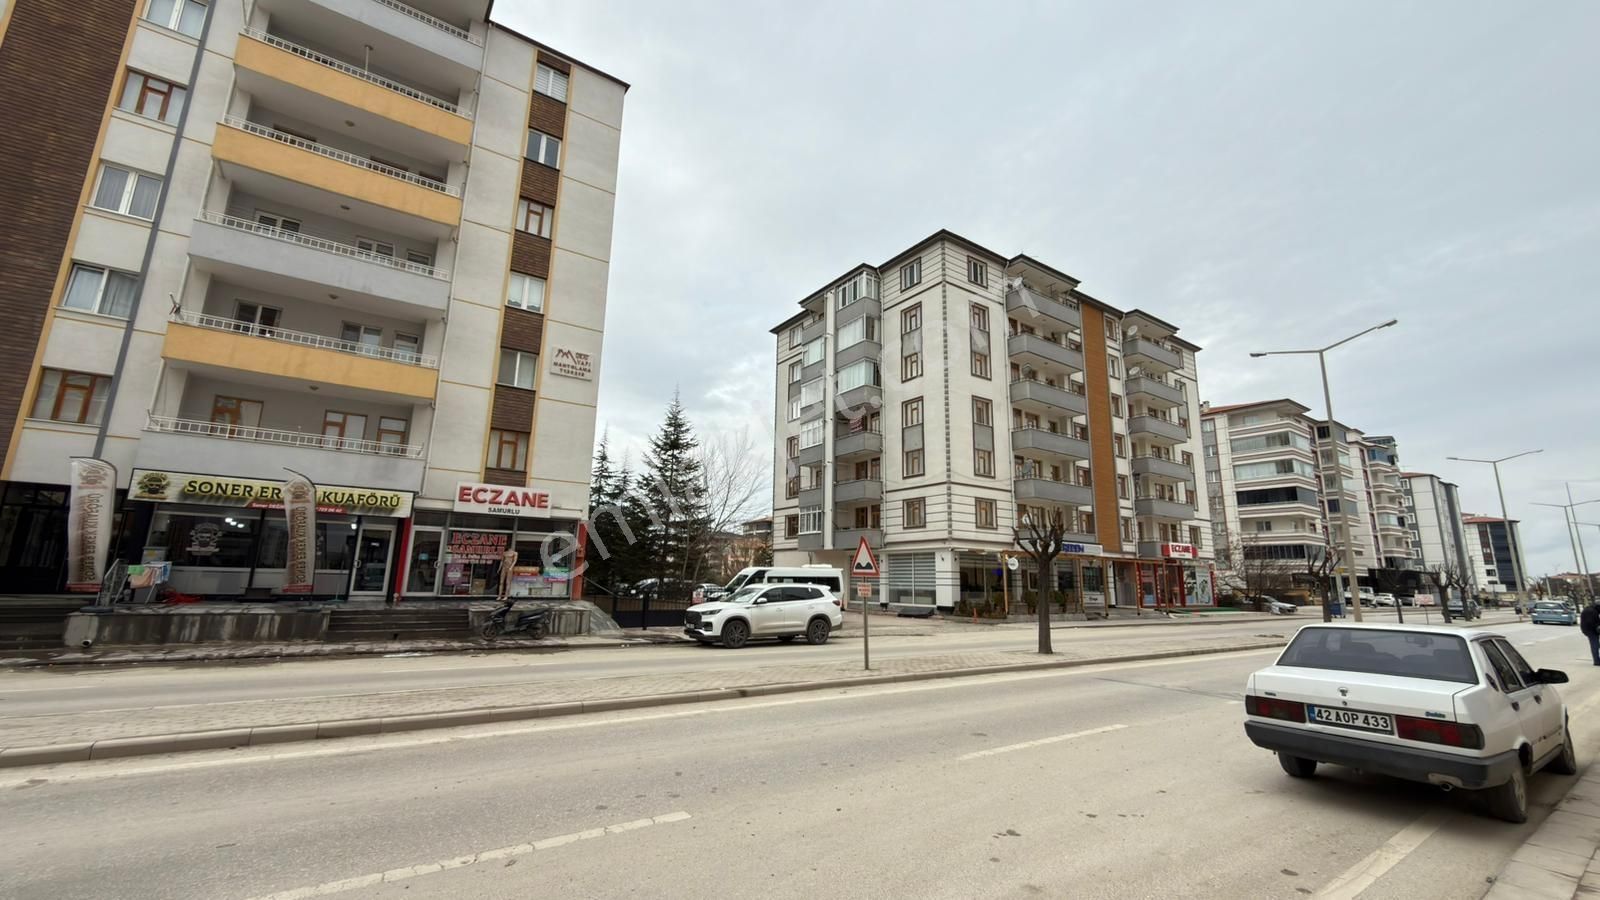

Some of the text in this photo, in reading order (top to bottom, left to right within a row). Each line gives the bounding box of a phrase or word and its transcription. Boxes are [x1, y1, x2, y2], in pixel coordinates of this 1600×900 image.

[186, 480, 253, 497] SONER
[322, 491, 401, 508] KUAFÖRÜ
[458, 486, 549, 509] ECZANE
[453, 531, 507, 545] ECZANE
[1316, 708, 1332, 721] 42
[1335, 711, 1359, 724] AOP
[1362, 715, 1389, 729] 433
